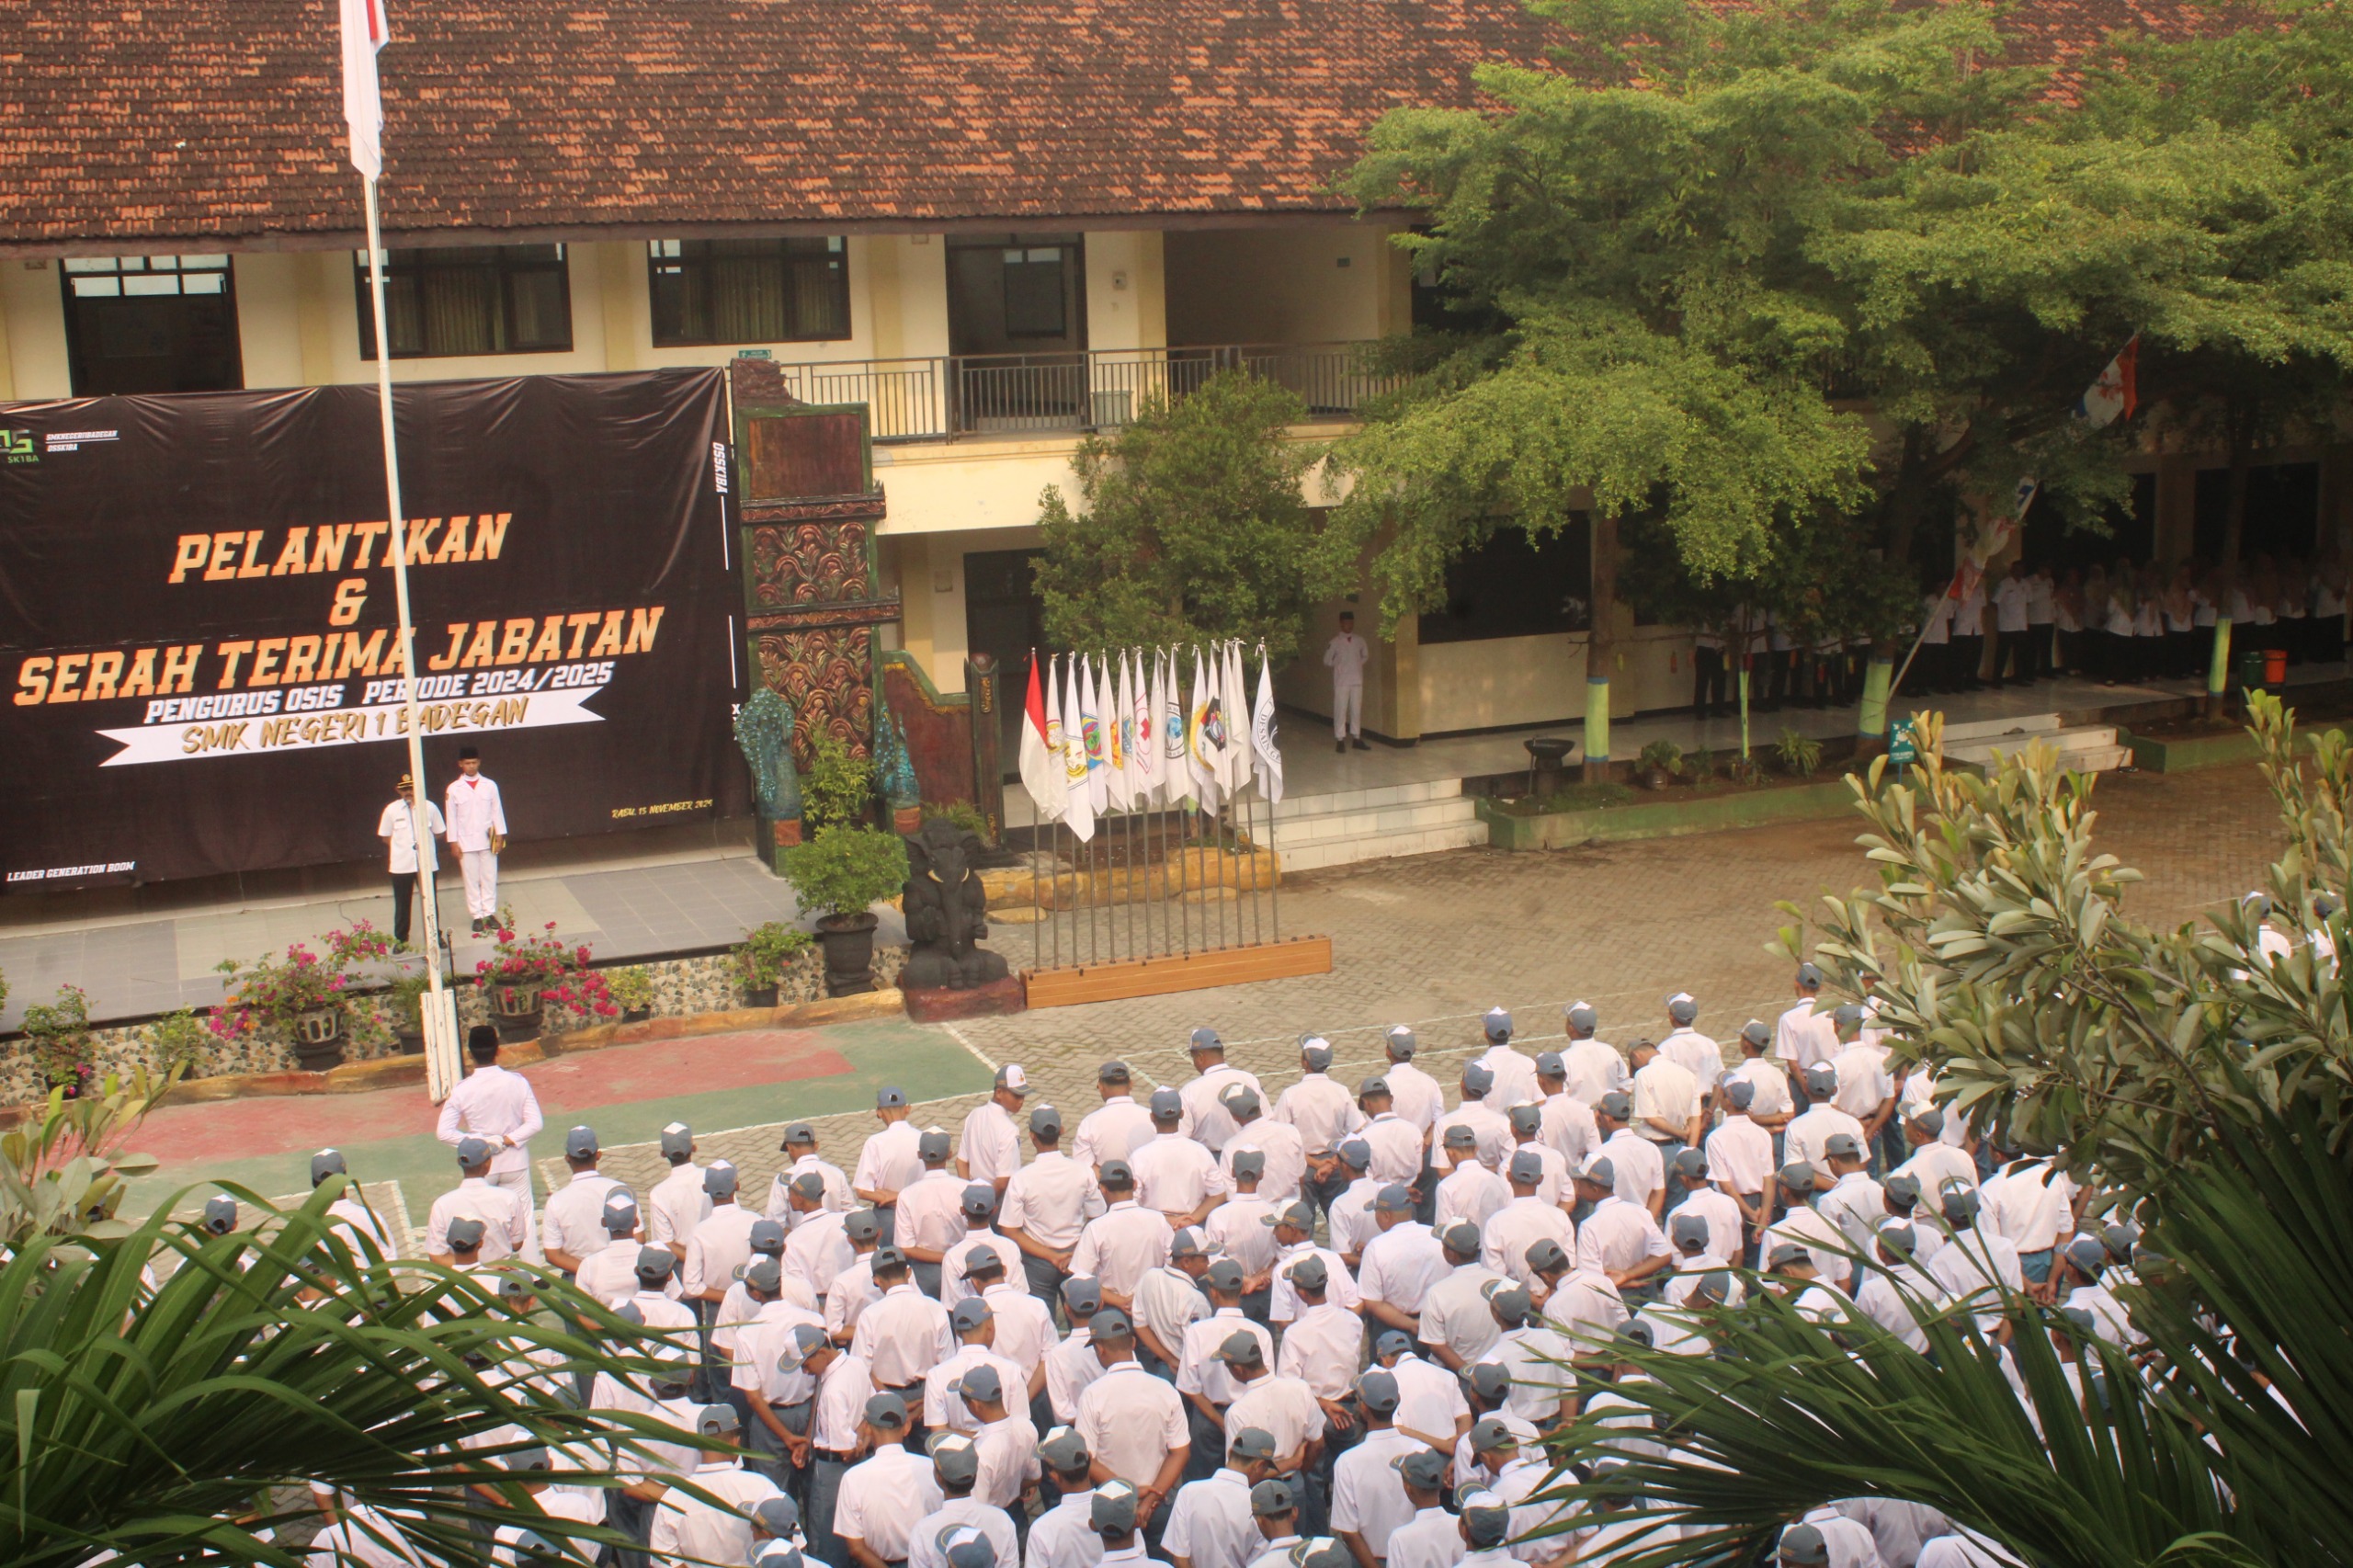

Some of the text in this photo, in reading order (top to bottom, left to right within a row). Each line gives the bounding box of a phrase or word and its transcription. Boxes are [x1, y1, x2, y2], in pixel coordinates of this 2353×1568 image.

[168, 513, 512, 584] PELANTIKAN
[328, 578, 368, 626] &
[14, 606, 665, 706] SERAH TERIMA JABATAN
[143, 690, 282, 724] PENGURUS
[285, 685, 346, 712] OSIS
[472, 661, 616, 695] 2024/2025
[182, 695, 529, 754] SMK NEGERI 1 BADEGAN
[649, 801, 693, 814] NOVEMBER
[6, 861, 135, 881] LEADER GENERATION BOOM
